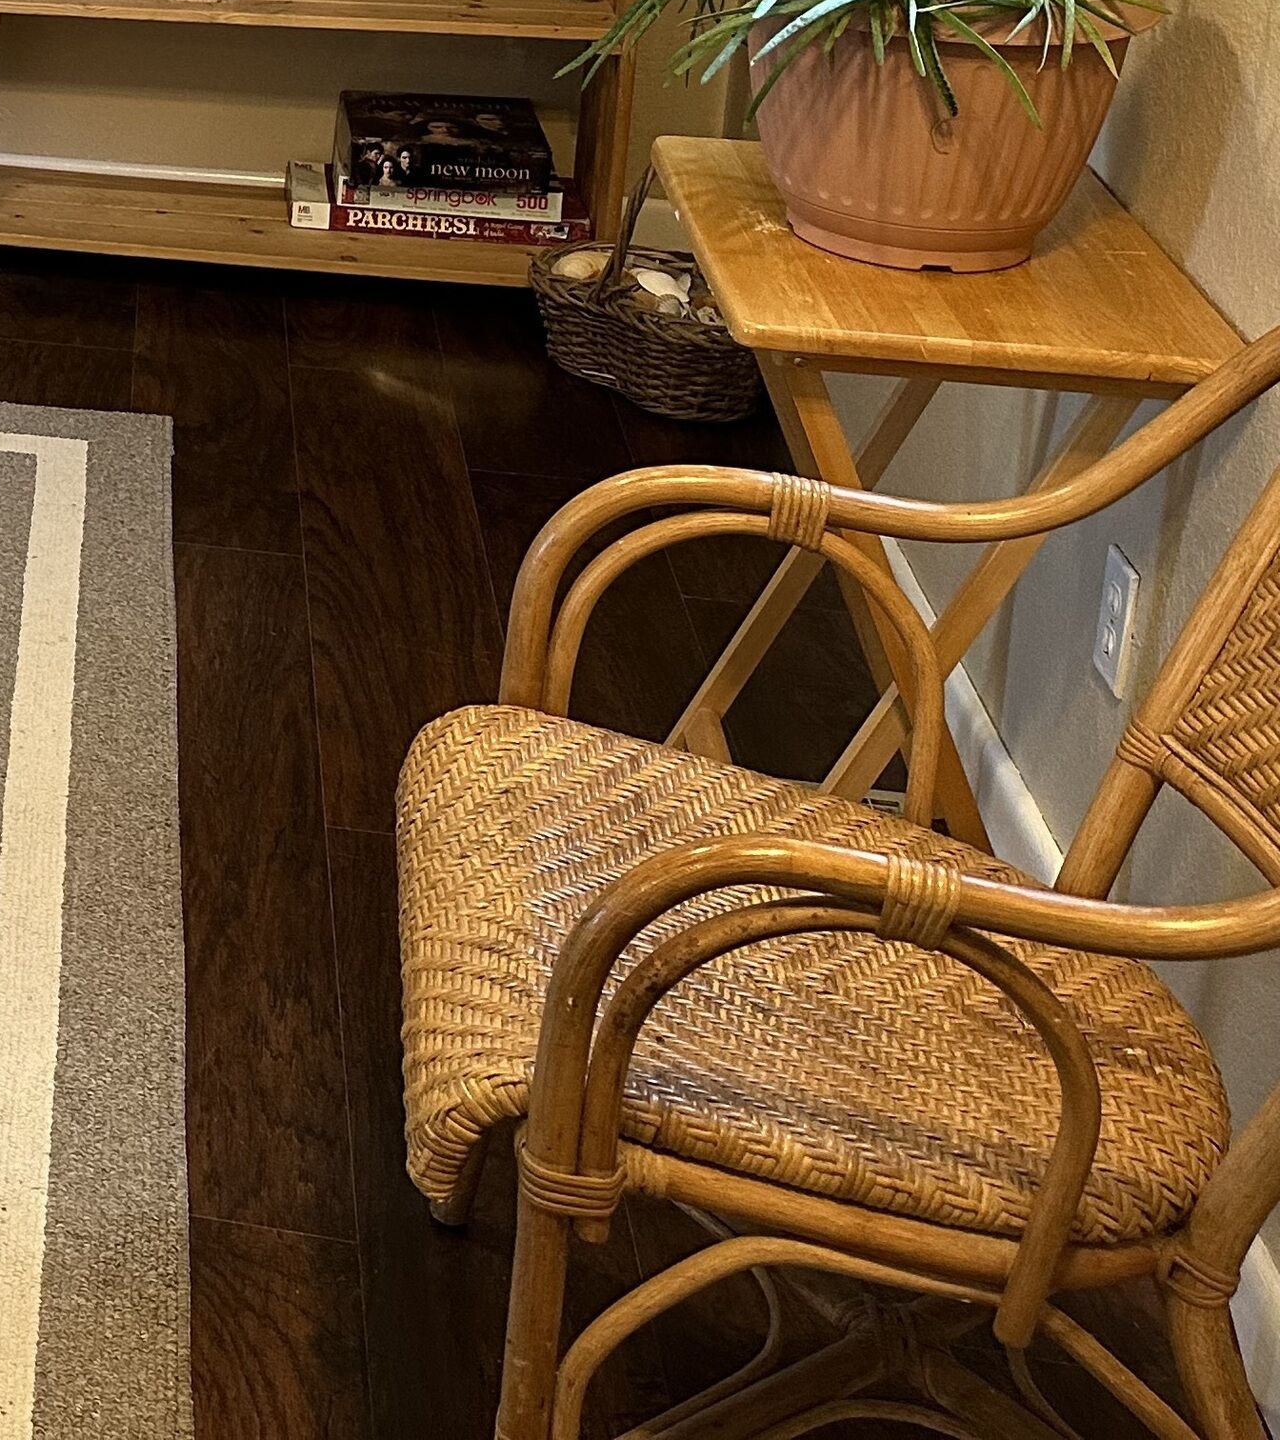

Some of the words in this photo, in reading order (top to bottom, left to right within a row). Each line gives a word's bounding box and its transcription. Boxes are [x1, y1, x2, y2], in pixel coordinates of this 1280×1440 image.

[430, 163, 471, 177] new
[475, 165, 531, 180] moon
[406, 187, 498, 208] springbok
[516, 194, 549, 210] 500
[346, 209, 476, 235] PARCHEESI
